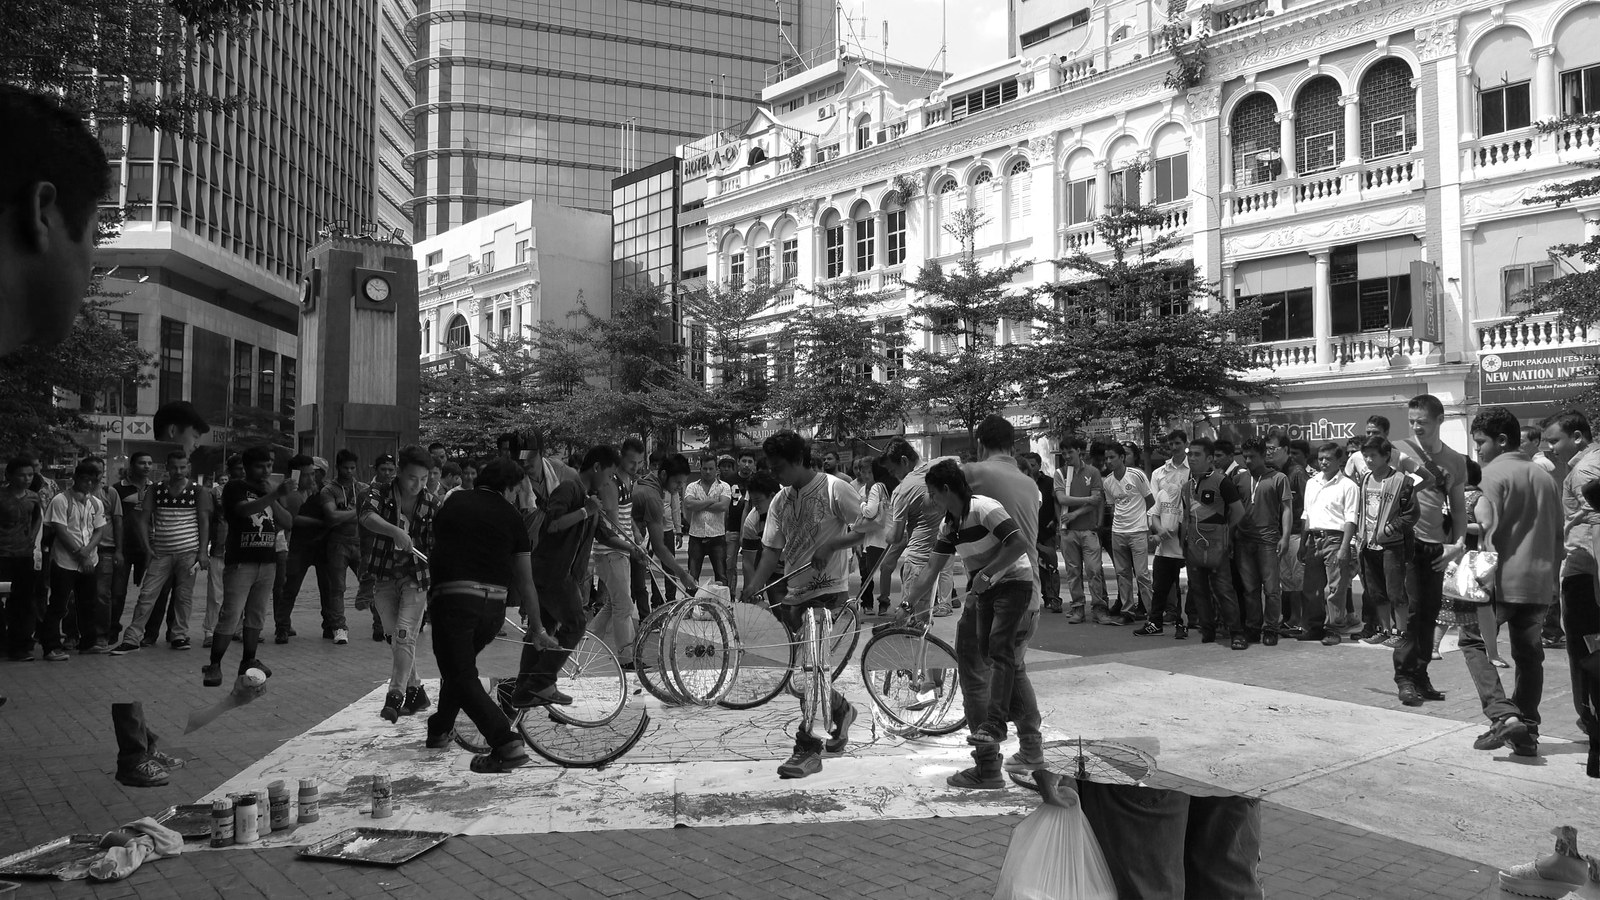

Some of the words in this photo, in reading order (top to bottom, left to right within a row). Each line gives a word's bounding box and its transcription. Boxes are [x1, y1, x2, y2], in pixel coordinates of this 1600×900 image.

[684, 154, 712, 176] HOTEL
[1502, 359, 1526, 368] BUTIK
[1526, 356, 1561, 366] PAKAIAN
[1485, 371, 1510, 383] NEW
[1512, 368, 1554, 380] NATION
